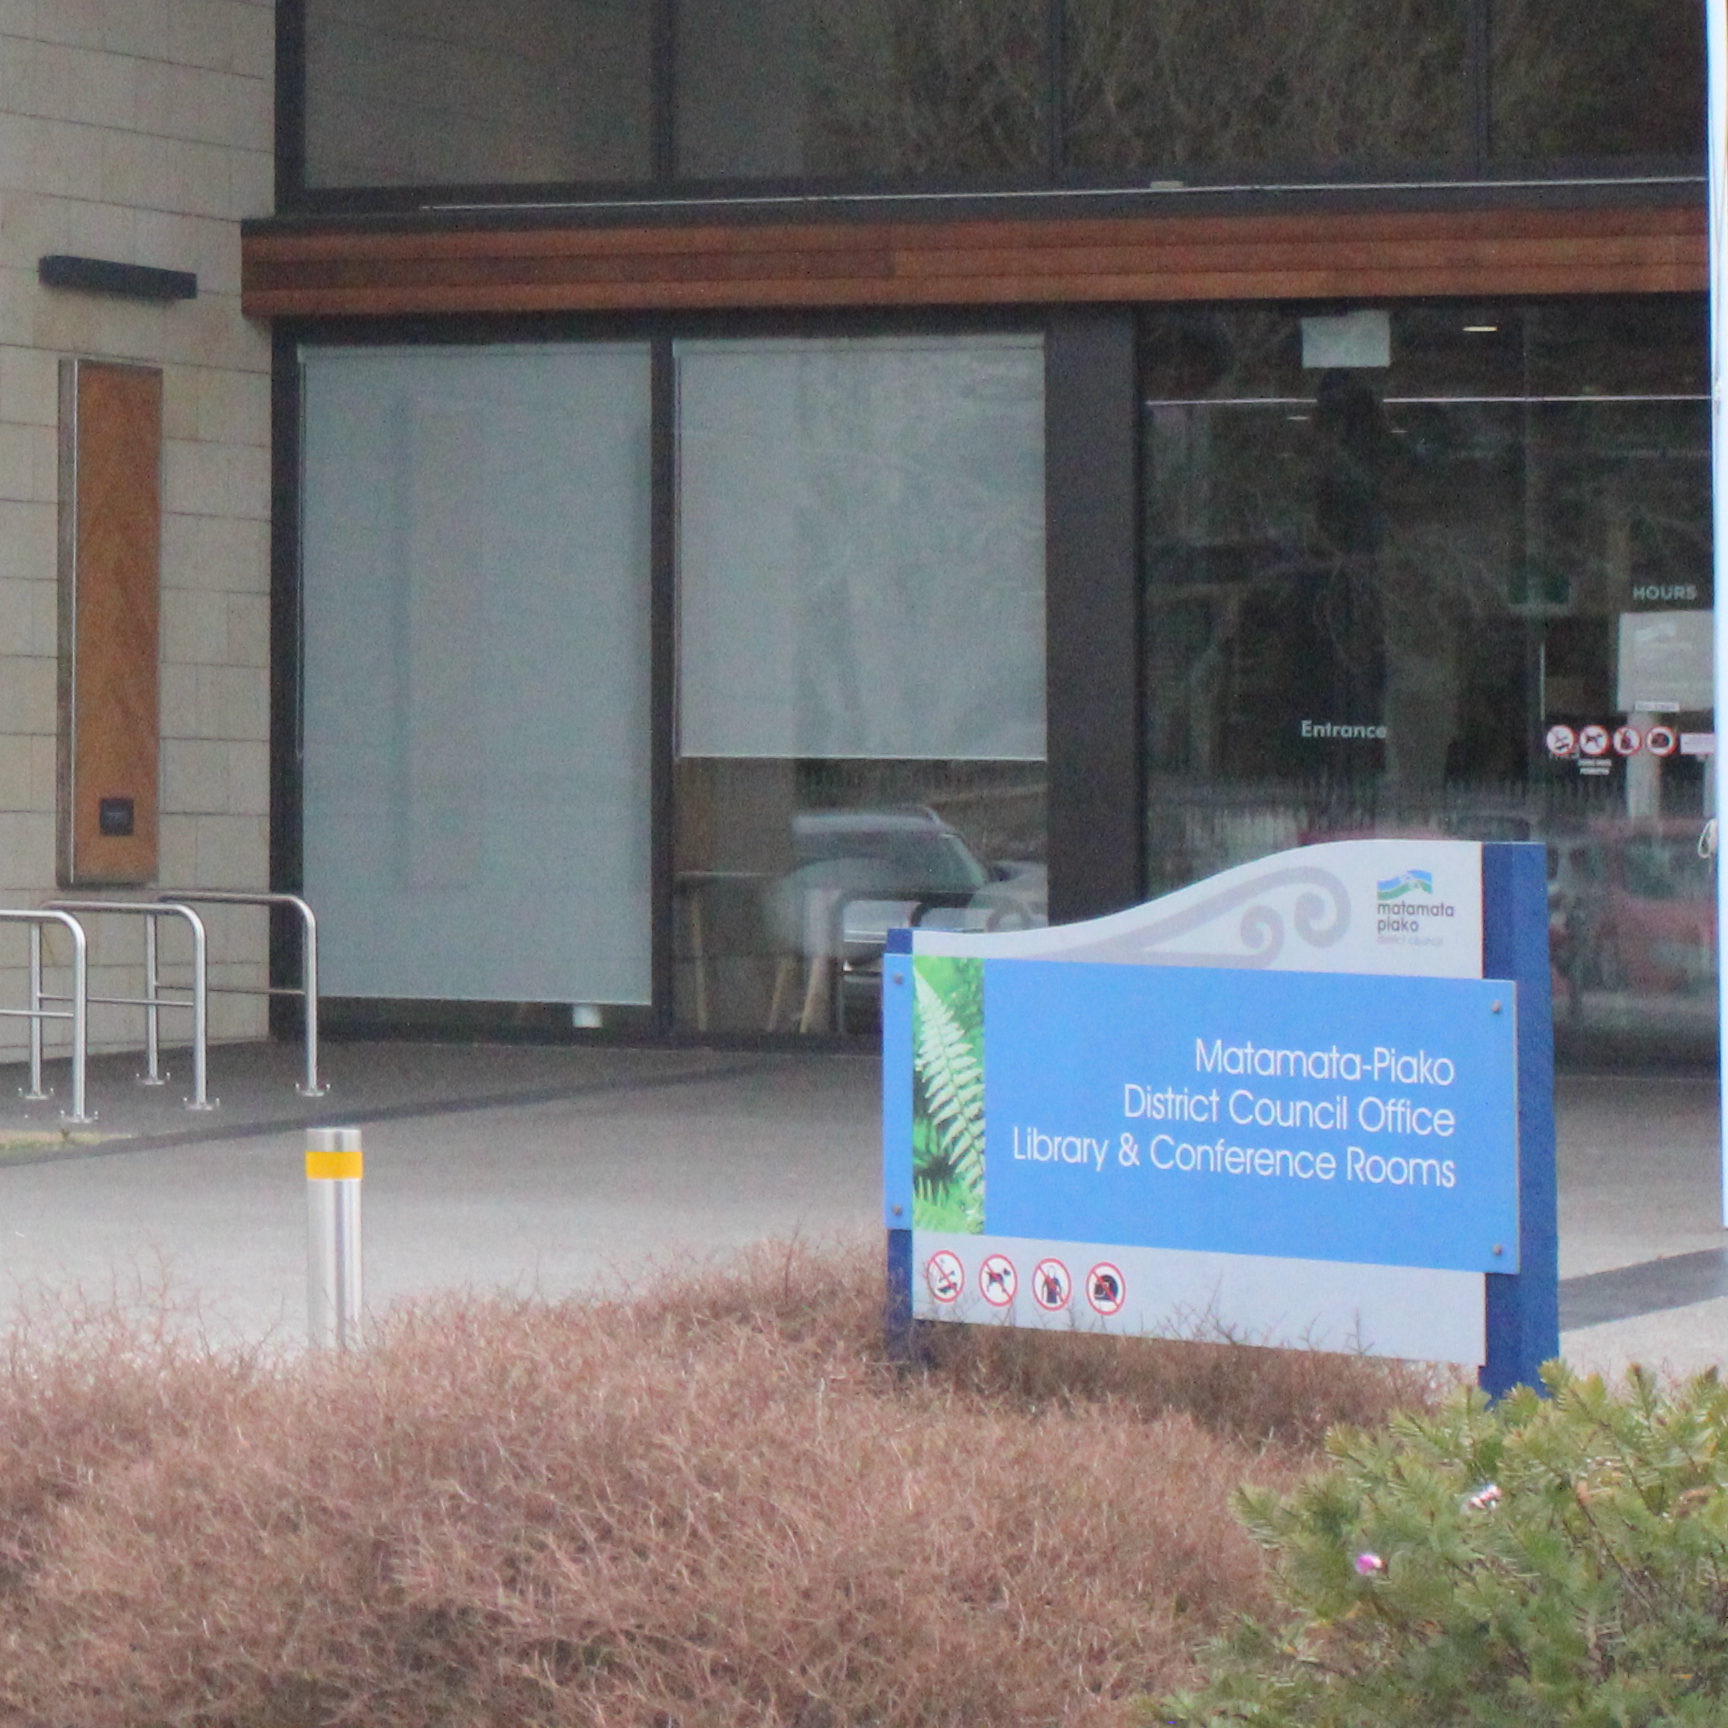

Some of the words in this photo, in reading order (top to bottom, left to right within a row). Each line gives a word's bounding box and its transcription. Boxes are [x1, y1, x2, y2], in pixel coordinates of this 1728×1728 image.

[1632, 585, 1697, 601] HOURS
[1301, 719, 1387, 739] Entrance
[1377, 901, 1455, 917] matamata
[1377, 917, 1419, 934] piako
[1196, 1038, 1455, 1085] Matamata-Piako
[1125, 1084, 1220, 1122] District
[1229, 1089, 1348, 1130] Council
[1359, 1097, 1456, 1136] Office
[1014, 1127, 1109, 1171] Library
[1119, 1132, 1140, 1167] &
[1150, 1134, 1336, 1180] Conference
[1347, 1146, 1456, 1188] Rooms
